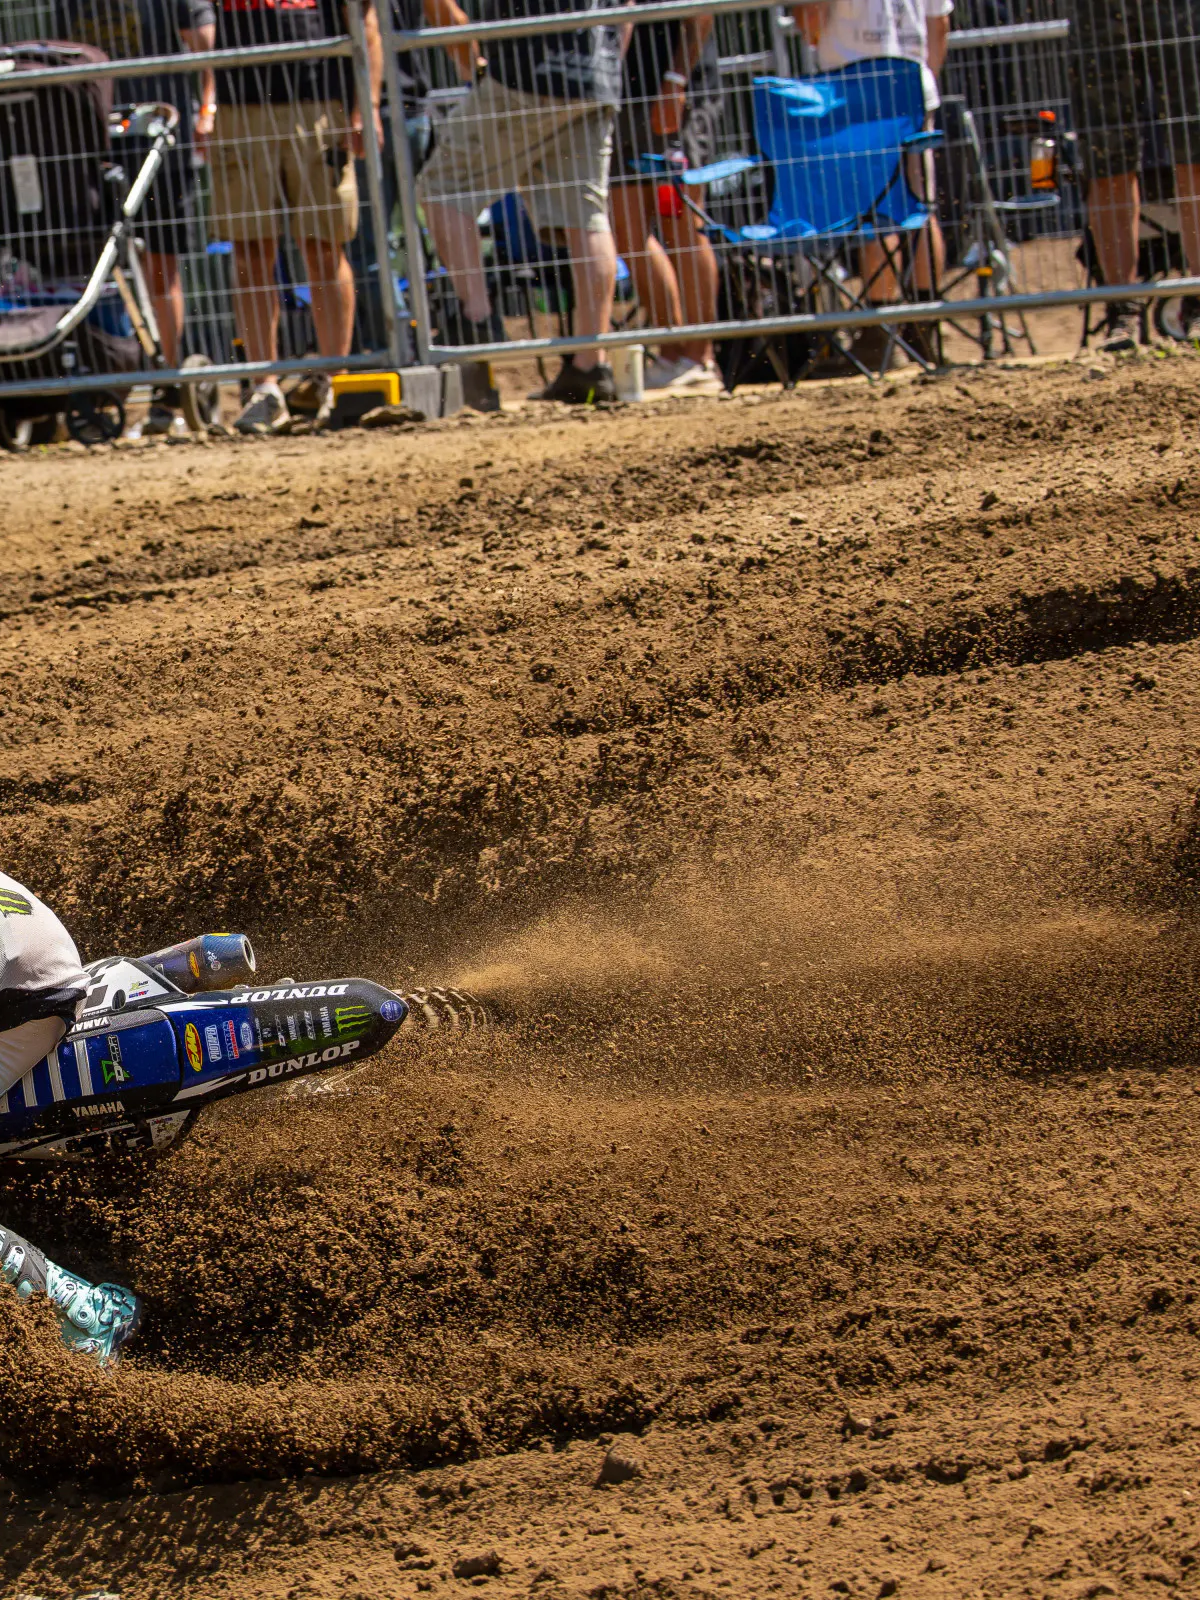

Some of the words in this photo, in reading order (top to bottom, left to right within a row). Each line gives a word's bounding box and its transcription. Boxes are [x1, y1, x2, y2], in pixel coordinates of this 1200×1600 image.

[231, 984, 349, 1004] DUNLOP
[72, 1016, 109, 1033] YAMA
[320, 1006, 332, 1038] YAMAHA
[185, 1023, 203, 1072] FMF
[206, 1025, 221, 1062] PROTAPER
[248, 1040, 360, 1084] DUNLOP
[72, 1101, 125, 1117] YAMAHA
